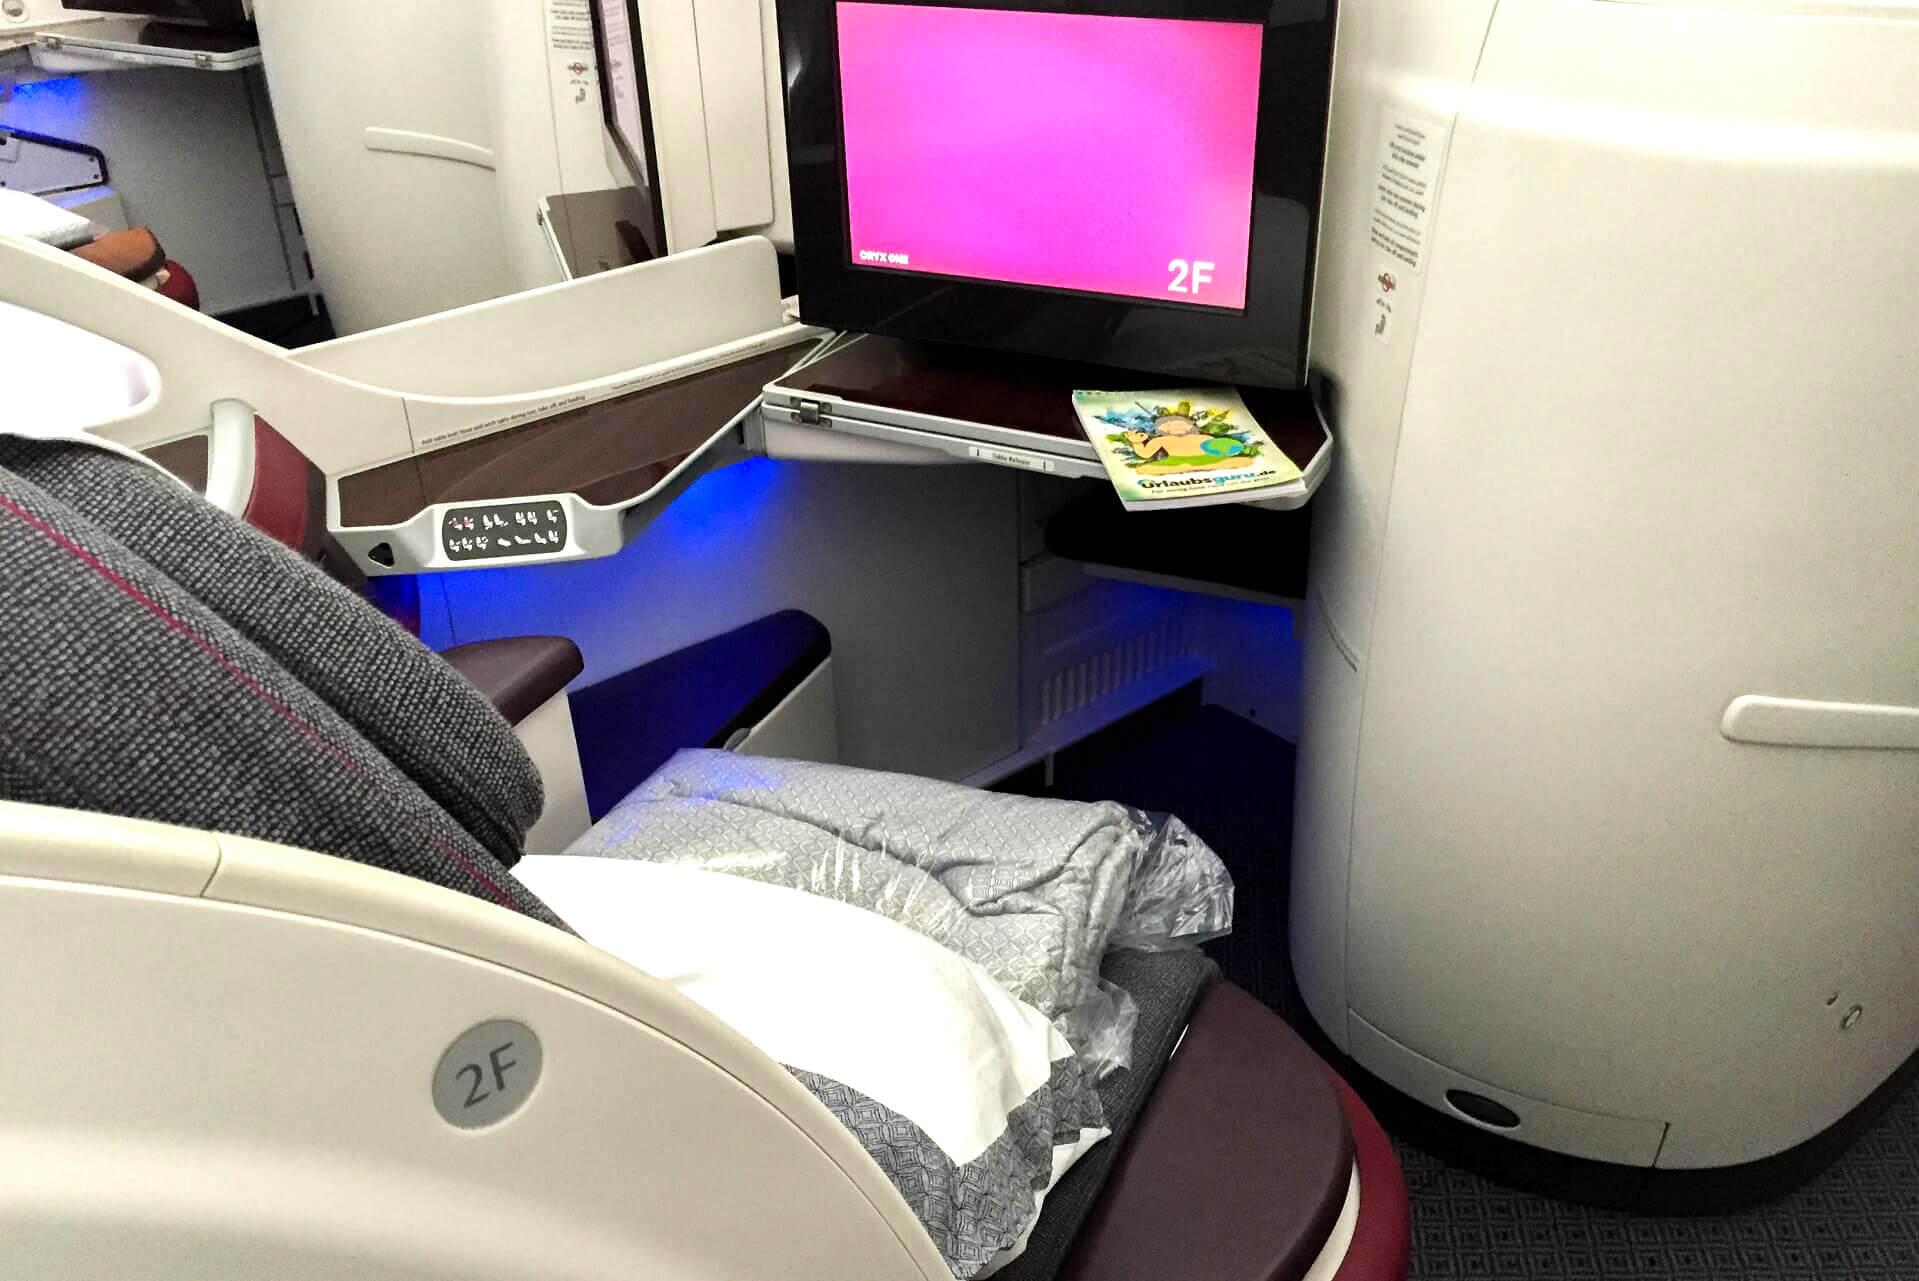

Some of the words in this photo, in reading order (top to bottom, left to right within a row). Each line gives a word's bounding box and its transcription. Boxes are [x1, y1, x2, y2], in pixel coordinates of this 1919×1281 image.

[860, 250, 887, 263] ORYX
[888, 253, 909, 265] ONE
[1167, 258, 1216, 294] 2F
[1138, 469, 1277, 488] Urlaubsguru.de
[456, 1041, 516, 1109] 2F
